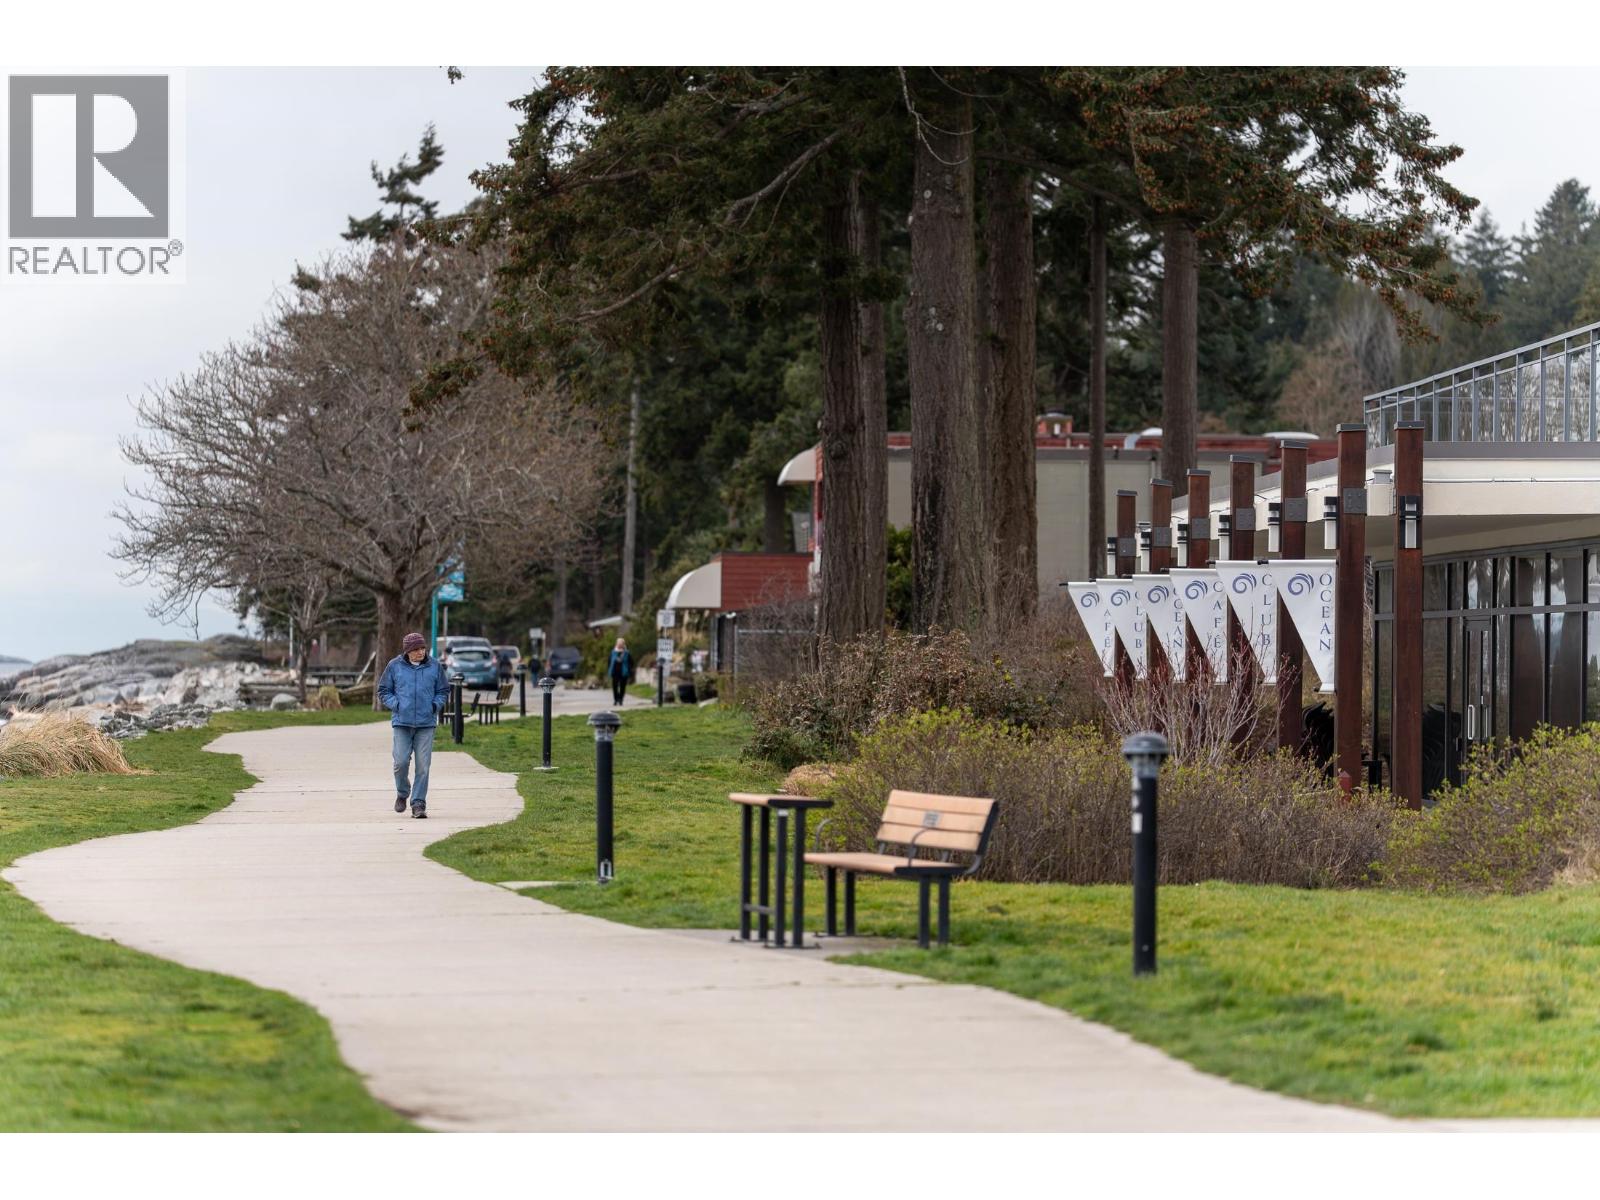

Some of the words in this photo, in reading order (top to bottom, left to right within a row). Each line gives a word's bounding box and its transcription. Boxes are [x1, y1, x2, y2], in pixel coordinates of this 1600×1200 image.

[1103, 609, 1111, 648] AFÉ
[1212, 581, 1225, 649] CAFÉ
[1261, 573, 1273, 646] CLUB
[1319, 573, 1333, 651] OCEAN
